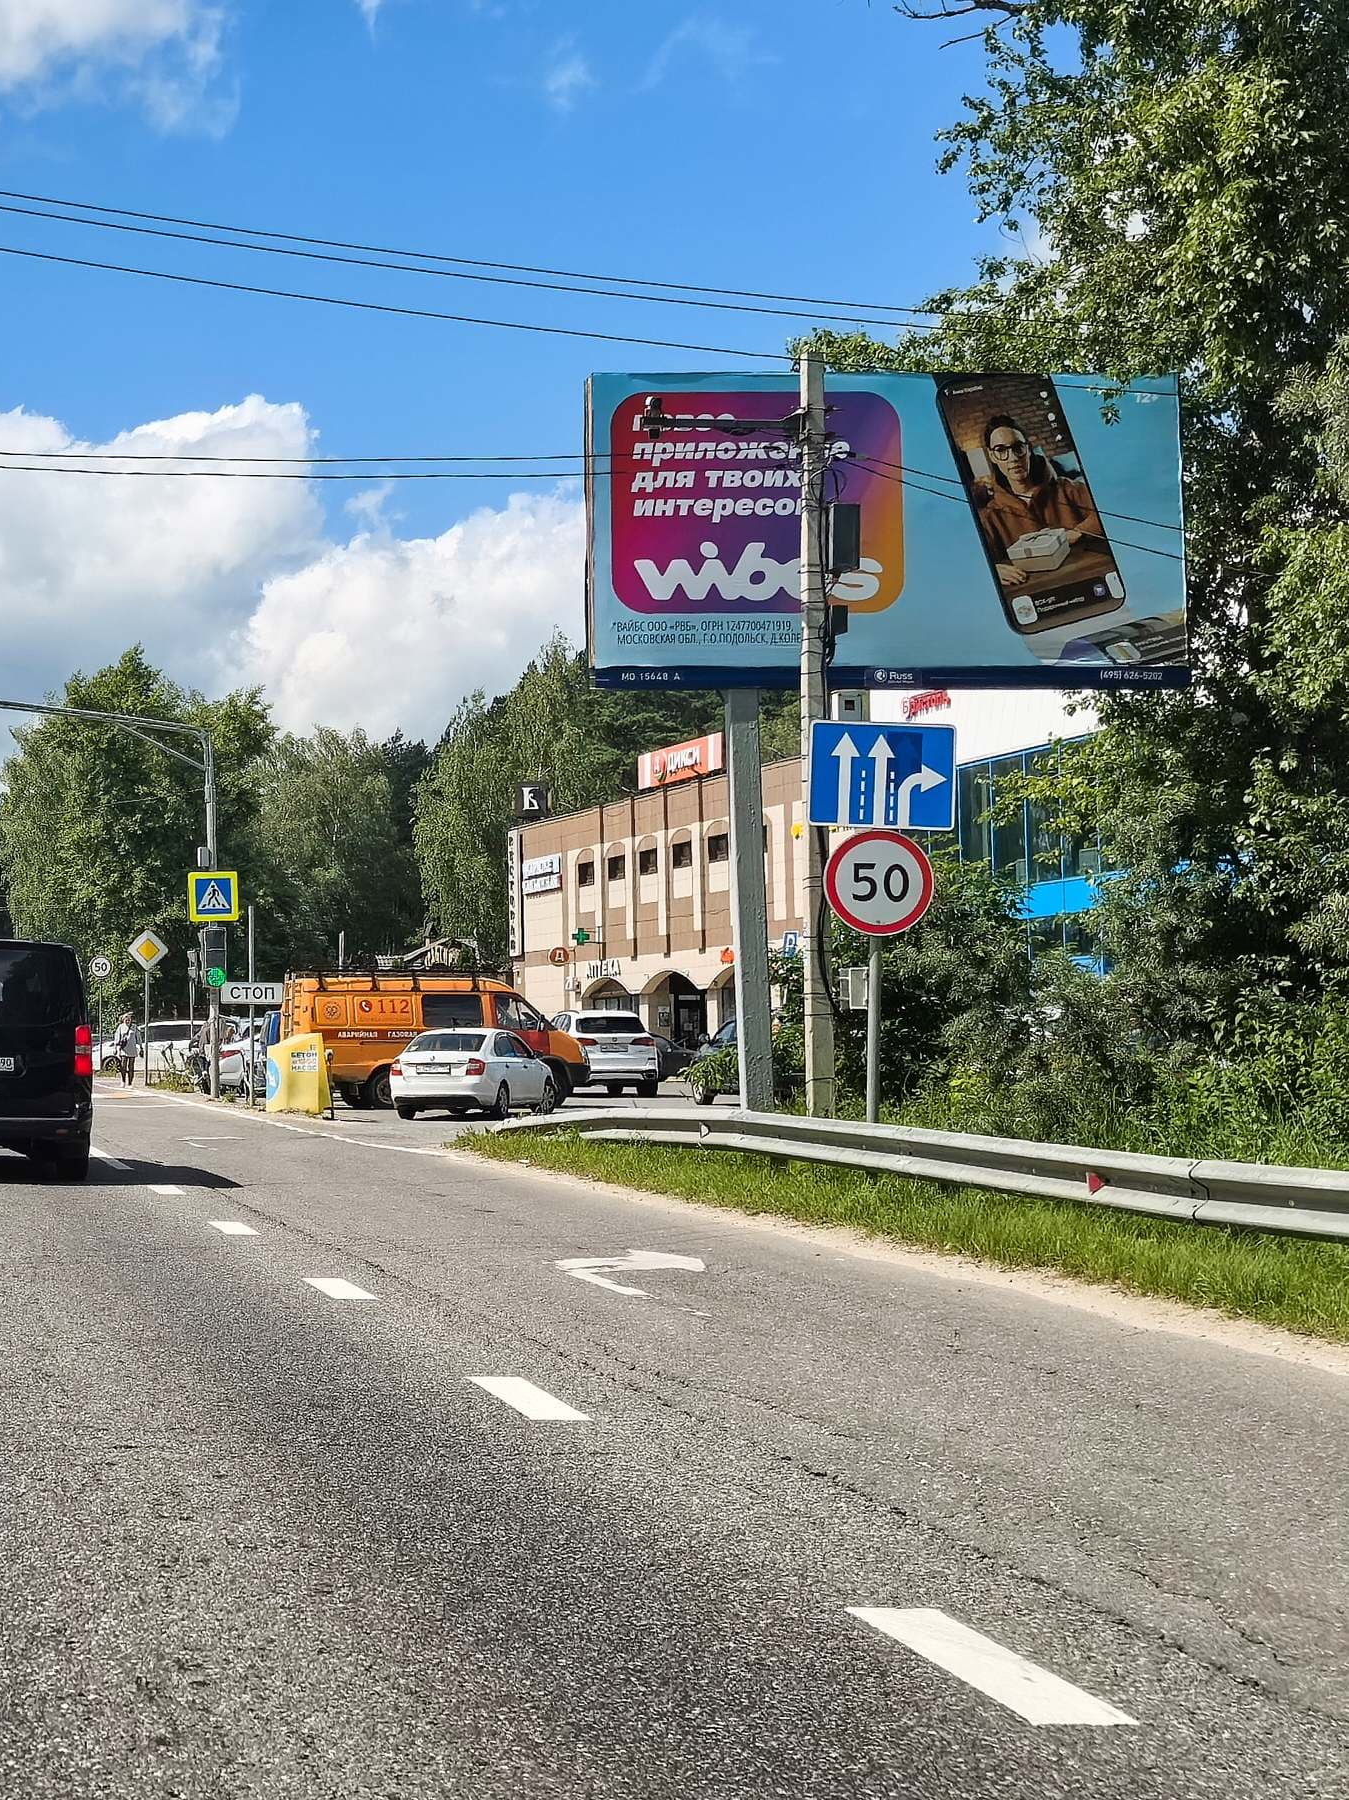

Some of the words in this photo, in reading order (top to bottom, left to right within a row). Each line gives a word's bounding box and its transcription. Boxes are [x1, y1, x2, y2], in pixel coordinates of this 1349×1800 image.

[631, 471, 695, 493] для
[705, 470, 802, 488] твоих
[647, 620, 667, 632] ООО
[700, 620, 724, 632] ОГРН
[617, 633, 676, 645] МОСКОВСКАЯ
[889, 671, 913, 680] Russ
[667, 746, 701, 774] ДИКСИ
[852, 863, 910, 903] 50
[95, 962, 108, 971] 50
[587, 960, 621, 979] АПТЕКА
[230, 986, 275, 1000] СТОП
[377, 999, 410, 1014] 112
[337, 1030, 378, 1038] АВАРИЙНАЯ
